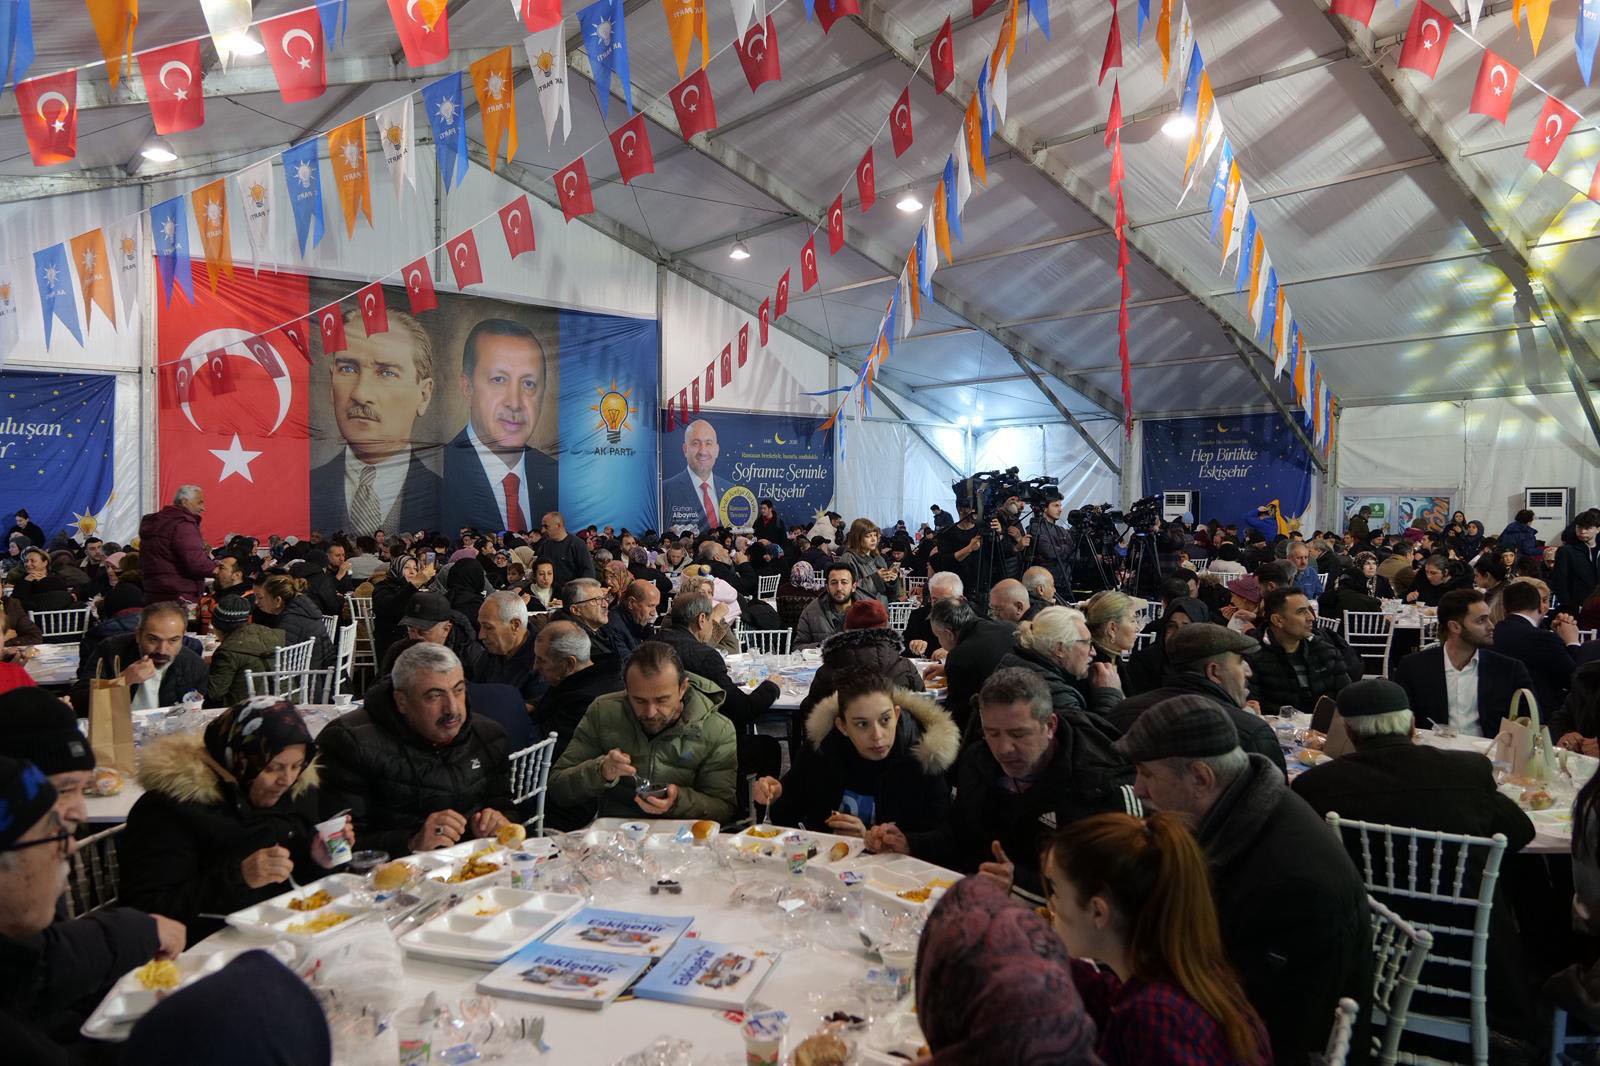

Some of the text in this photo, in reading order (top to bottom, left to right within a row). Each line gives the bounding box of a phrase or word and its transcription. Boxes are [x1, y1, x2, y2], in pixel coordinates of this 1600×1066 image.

[594, 447, 607, 456] AK
[1190, 447, 1258, 465] Hep Birlikte
[731, 462, 828, 483] Soframız Seninle
[1198, 464, 1253, 481] Eskişehir
[758, 482, 811, 502] Eskişehir
